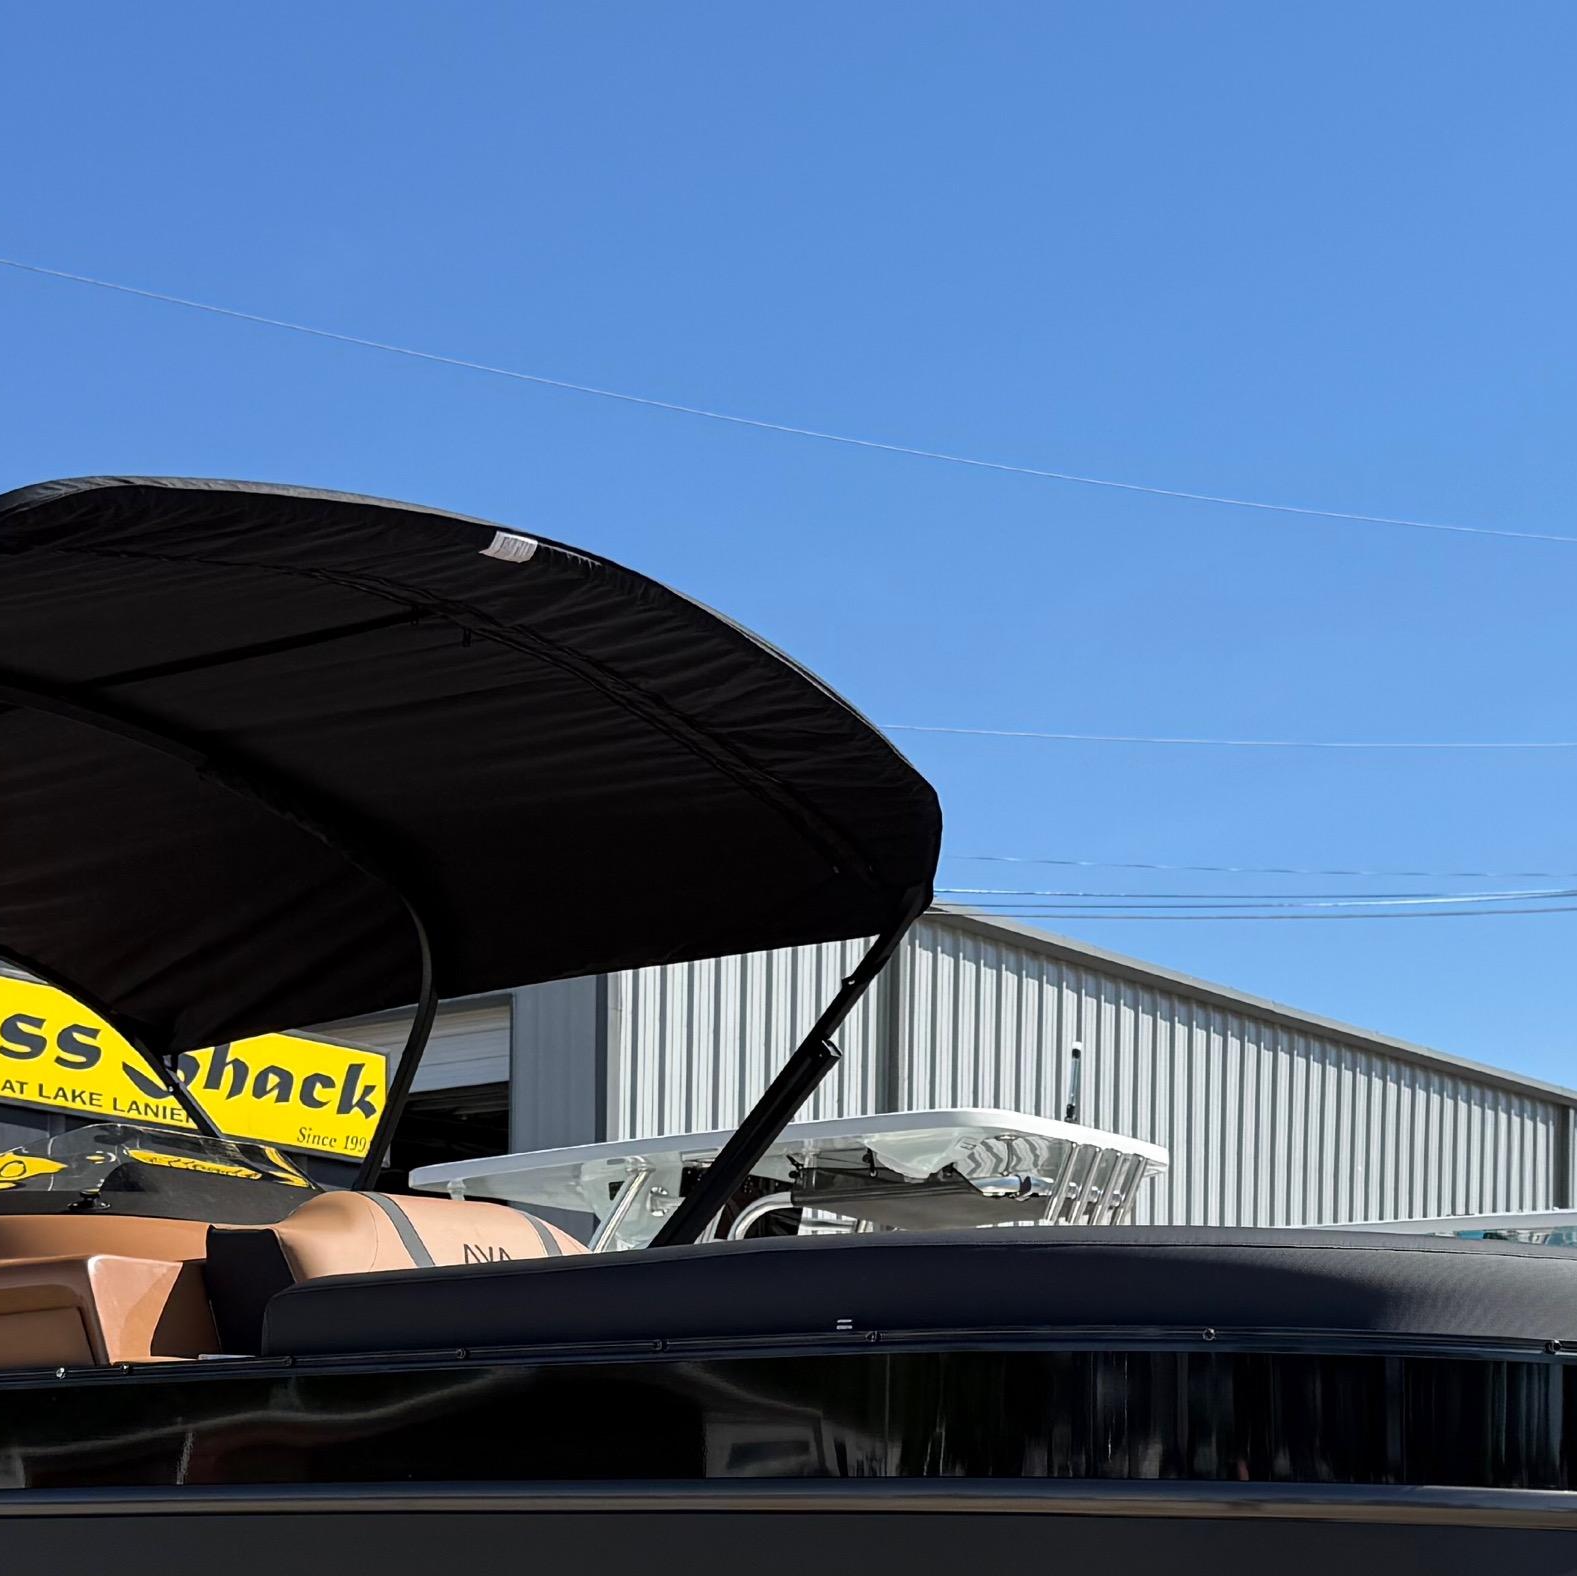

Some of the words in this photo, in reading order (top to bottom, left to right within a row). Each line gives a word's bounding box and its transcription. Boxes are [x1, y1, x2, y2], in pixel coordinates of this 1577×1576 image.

[1, 1079, 28, 1095] AT
[38, 1083, 103, 1108] LAKE
[297, 1126, 337, 1148] Since
[343, 1135, 367, 1153] 199
